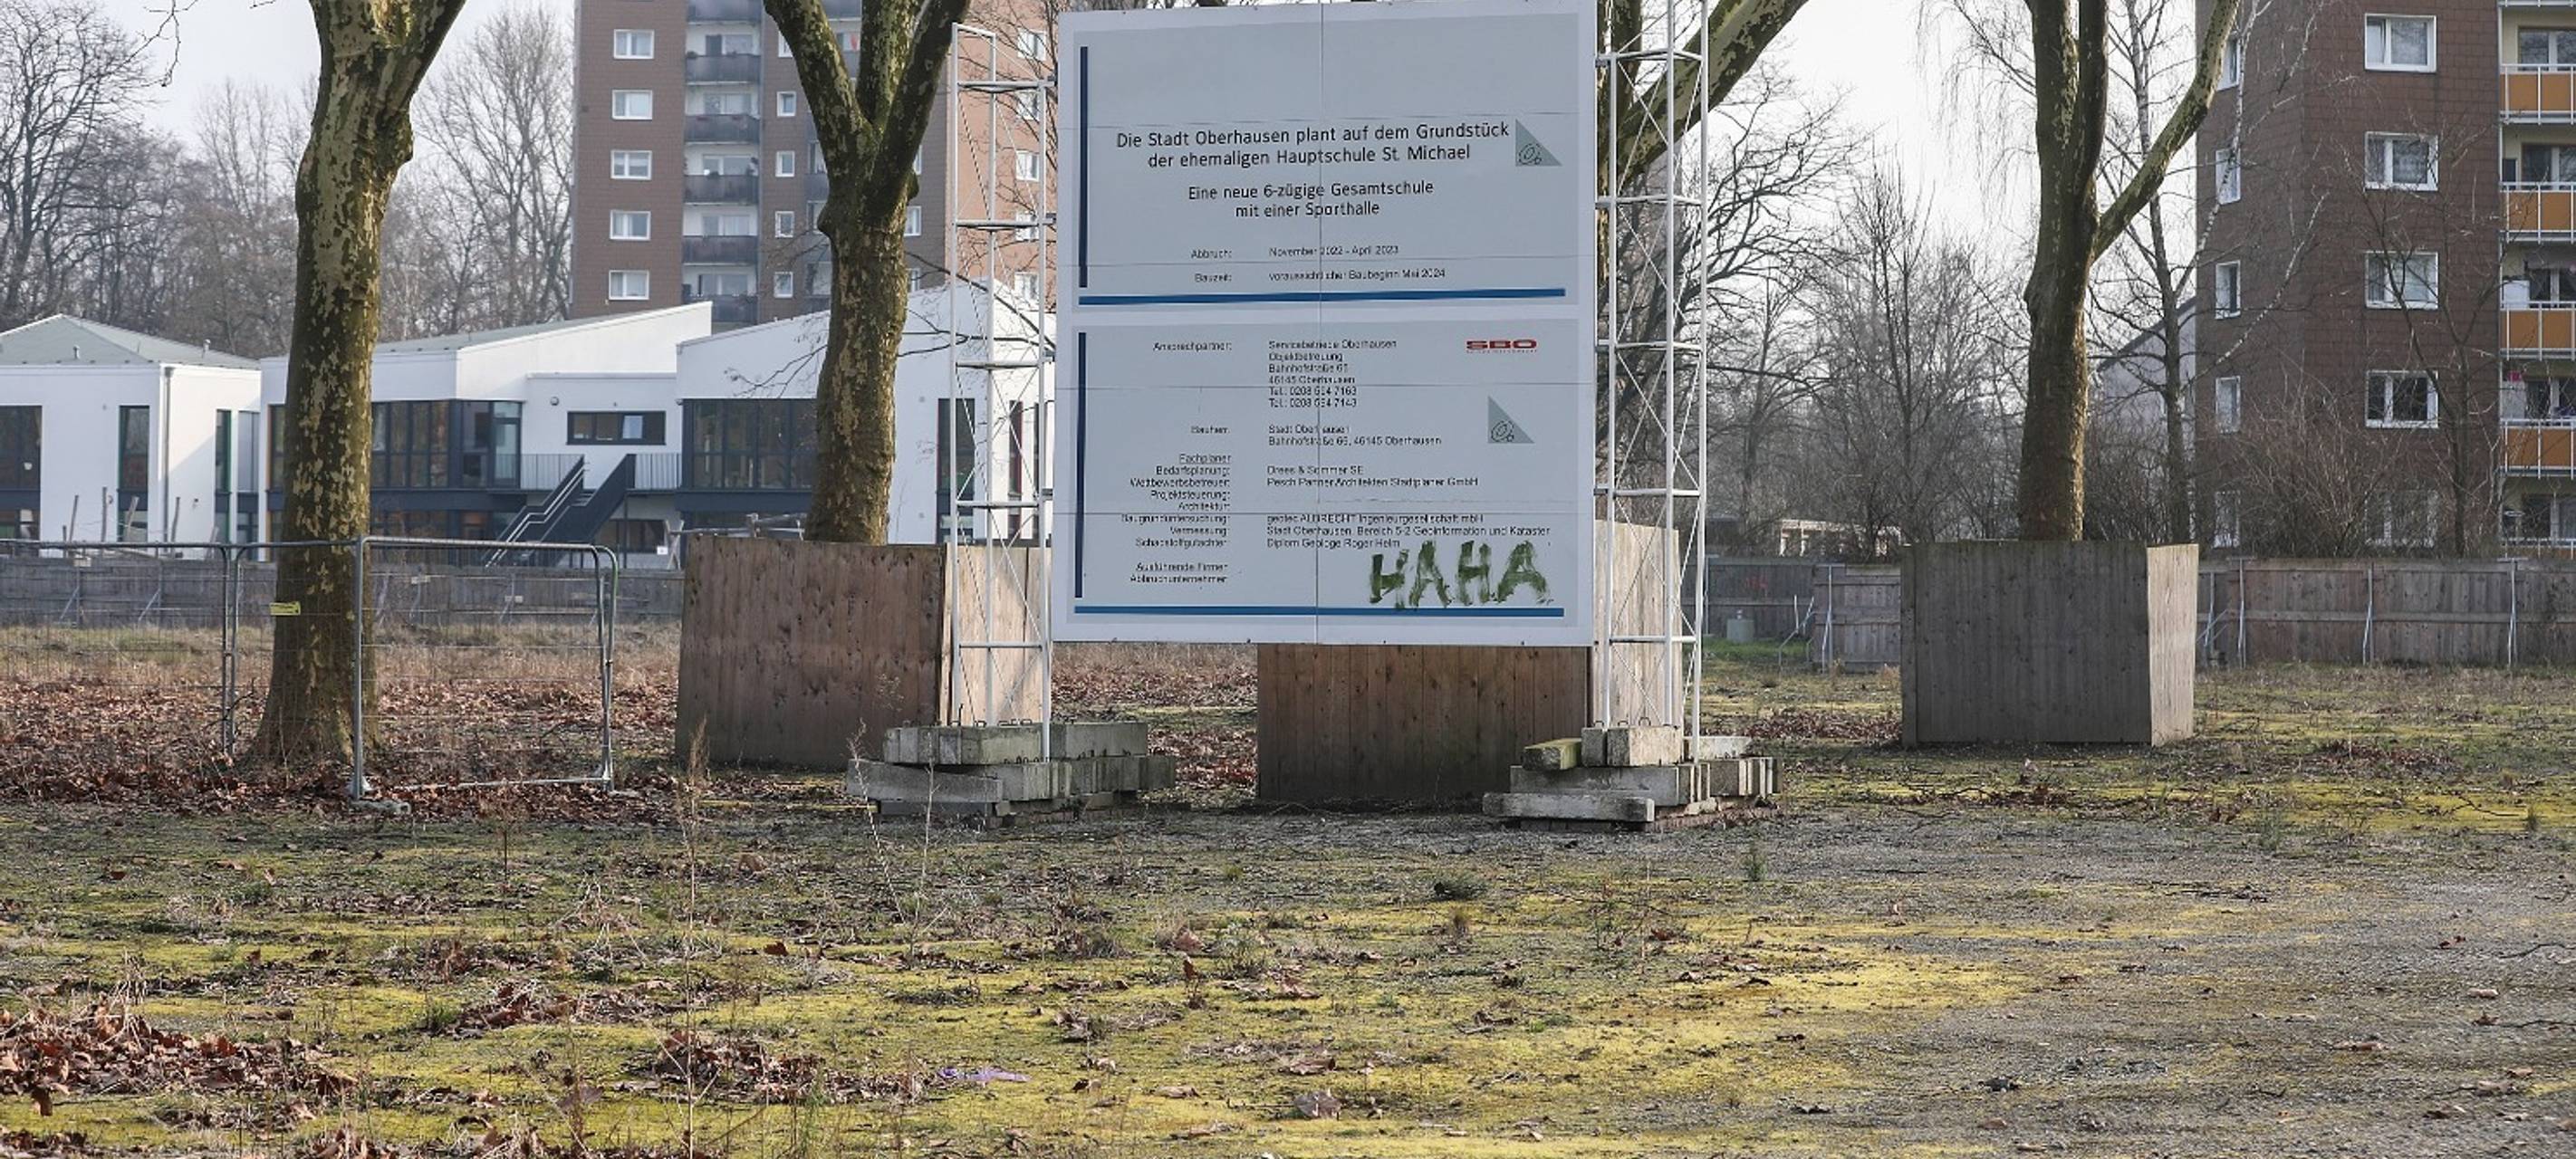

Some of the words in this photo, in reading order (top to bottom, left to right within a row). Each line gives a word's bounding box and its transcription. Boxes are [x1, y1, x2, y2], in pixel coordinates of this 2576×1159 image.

[1116, 132, 1142, 148] Die
[1148, 130, 1189, 147] Stadt
[1196, 129, 1290, 145] Oberhausen
[1296, 127, 1336, 145] plant
[1342, 126, 1369, 141] auf
[1374, 124, 1409, 139] dem
[1416, 121, 1510, 139] Grundstück
[1148, 153, 1174, 168] der
[1179, 150, 1270, 168] ehemaligen
[1276, 147, 1376, 165] Hauptschule
[1407, 143, 1470, 160] Michael
[1188, 186, 1218, 200] Eine
[1224, 187, 1258, 199] neue
[1264, 183, 1325, 200] 6-zügige
[1331, 180, 1435, 196] Gesamtschule
[1235, 204, 1259, 217] mit
[1264, 203, 1300, 217] einer
[1305, 200, 1380, 218] Sporthalle
[1269, 247, 1317, 257] November
[1351, 245, 1371, 257] April
[1466, 339, 1537, 350] SBO
[1384, 435, 1442, 446] Oberhausen
[1447, 476, 1479, 487] GmbH
[1488, 525, 1506, 536] und
[1508, 525, 1551, 536] Kataster
[1370, 541, 1550, 610] HAHA
